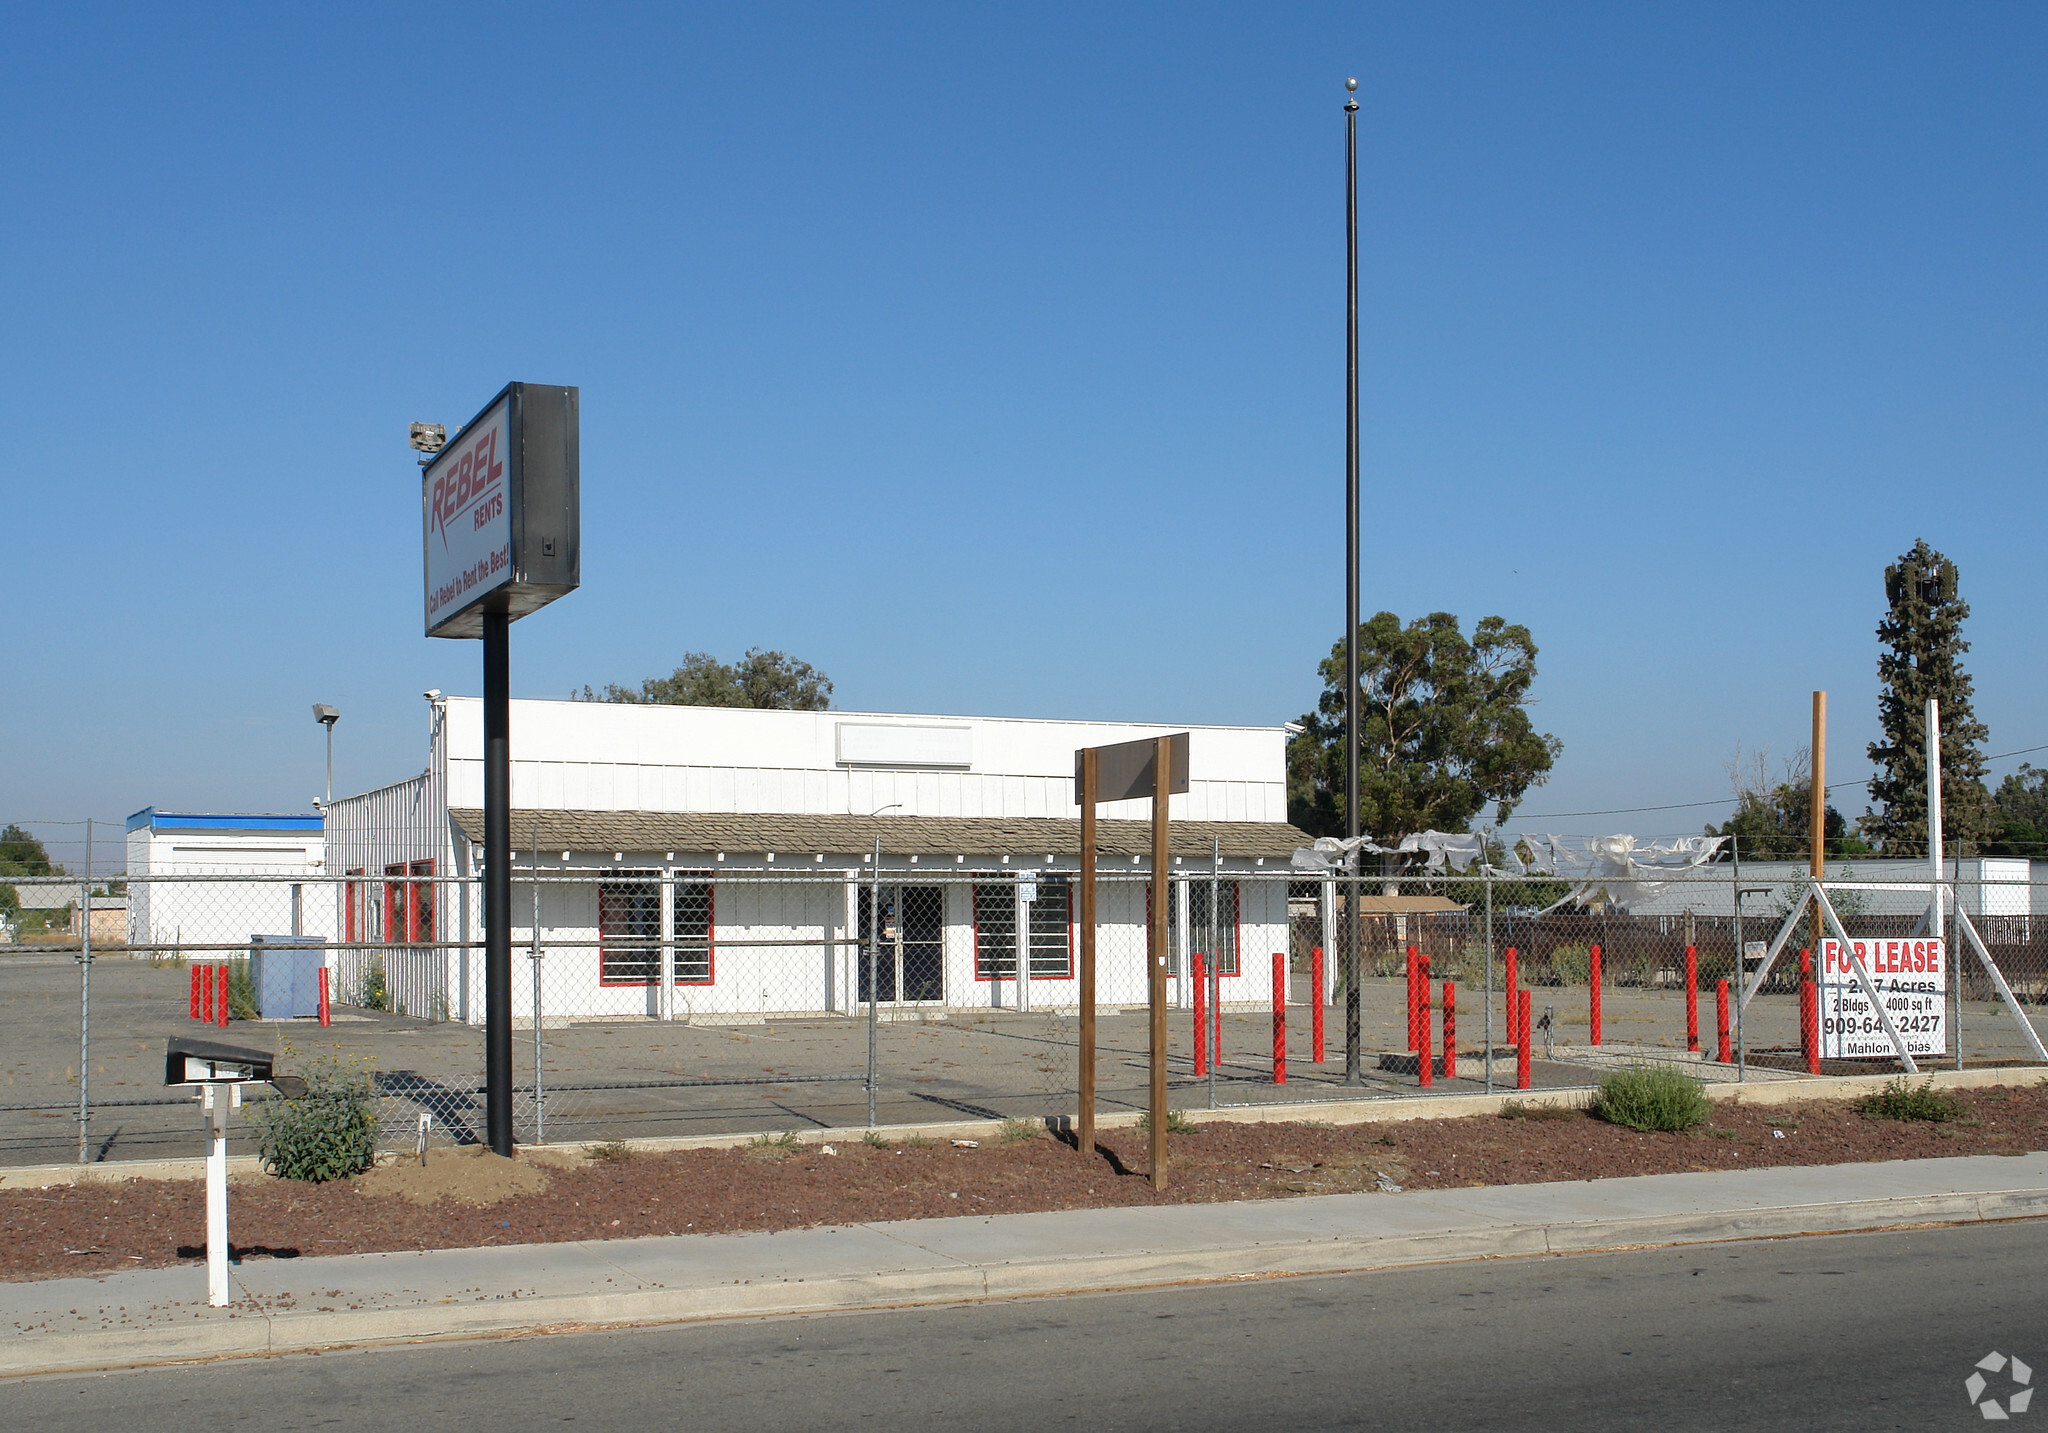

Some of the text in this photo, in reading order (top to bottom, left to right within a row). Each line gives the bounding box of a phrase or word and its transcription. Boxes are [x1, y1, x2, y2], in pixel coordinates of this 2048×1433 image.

[431, 426, 503, 554] REBEL
[474, 492, 503, 532] RENTS
[430, 542, 509, 614] Call Rebel to Rent the Best!
[1826, 941, 1939, 973] FOR LEASE
[1848, 979, 1883, 993] 2.7
[1889, 979, 1936, 993] Acres
[1833, 997, 1932, 1015] 2 Bldgs 4000 sq ft
[1825, 1016, 1940, 1034] 909-64-2427
[1847, 1043, 1890, 1054] Mahlon
